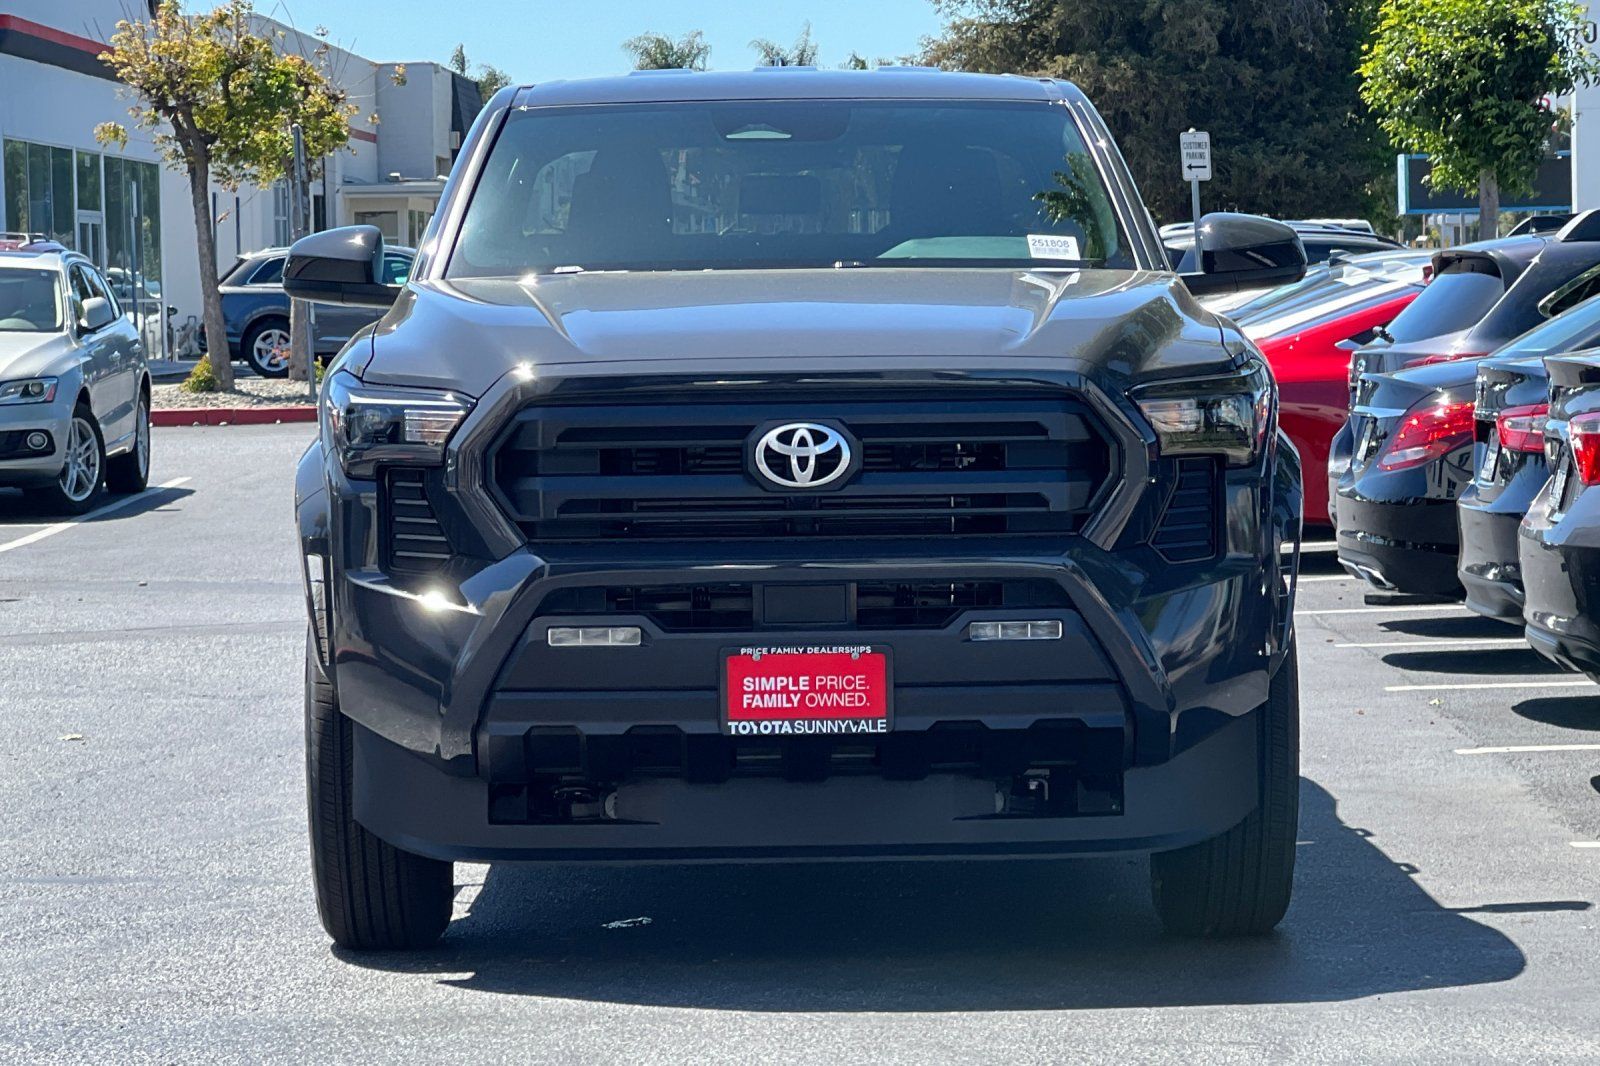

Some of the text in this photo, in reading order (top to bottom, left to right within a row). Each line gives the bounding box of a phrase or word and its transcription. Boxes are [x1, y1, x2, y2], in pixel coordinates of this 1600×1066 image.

[1183, 141, 1208, 150] CUSTOMER
[1185, 152, 1206, 160] PARKING
[1031, 238, 1070, 248] 251808
[740, 646, 872, 656] PRICE FAMILY DEALERSHIPS
[743, 675, 870, 691] SIMPLE PRICE.
[743, 692, 870, 708] FAMILY OWNED.
[728, 719, 887, 735] TOYOTA SUNNYVALE
